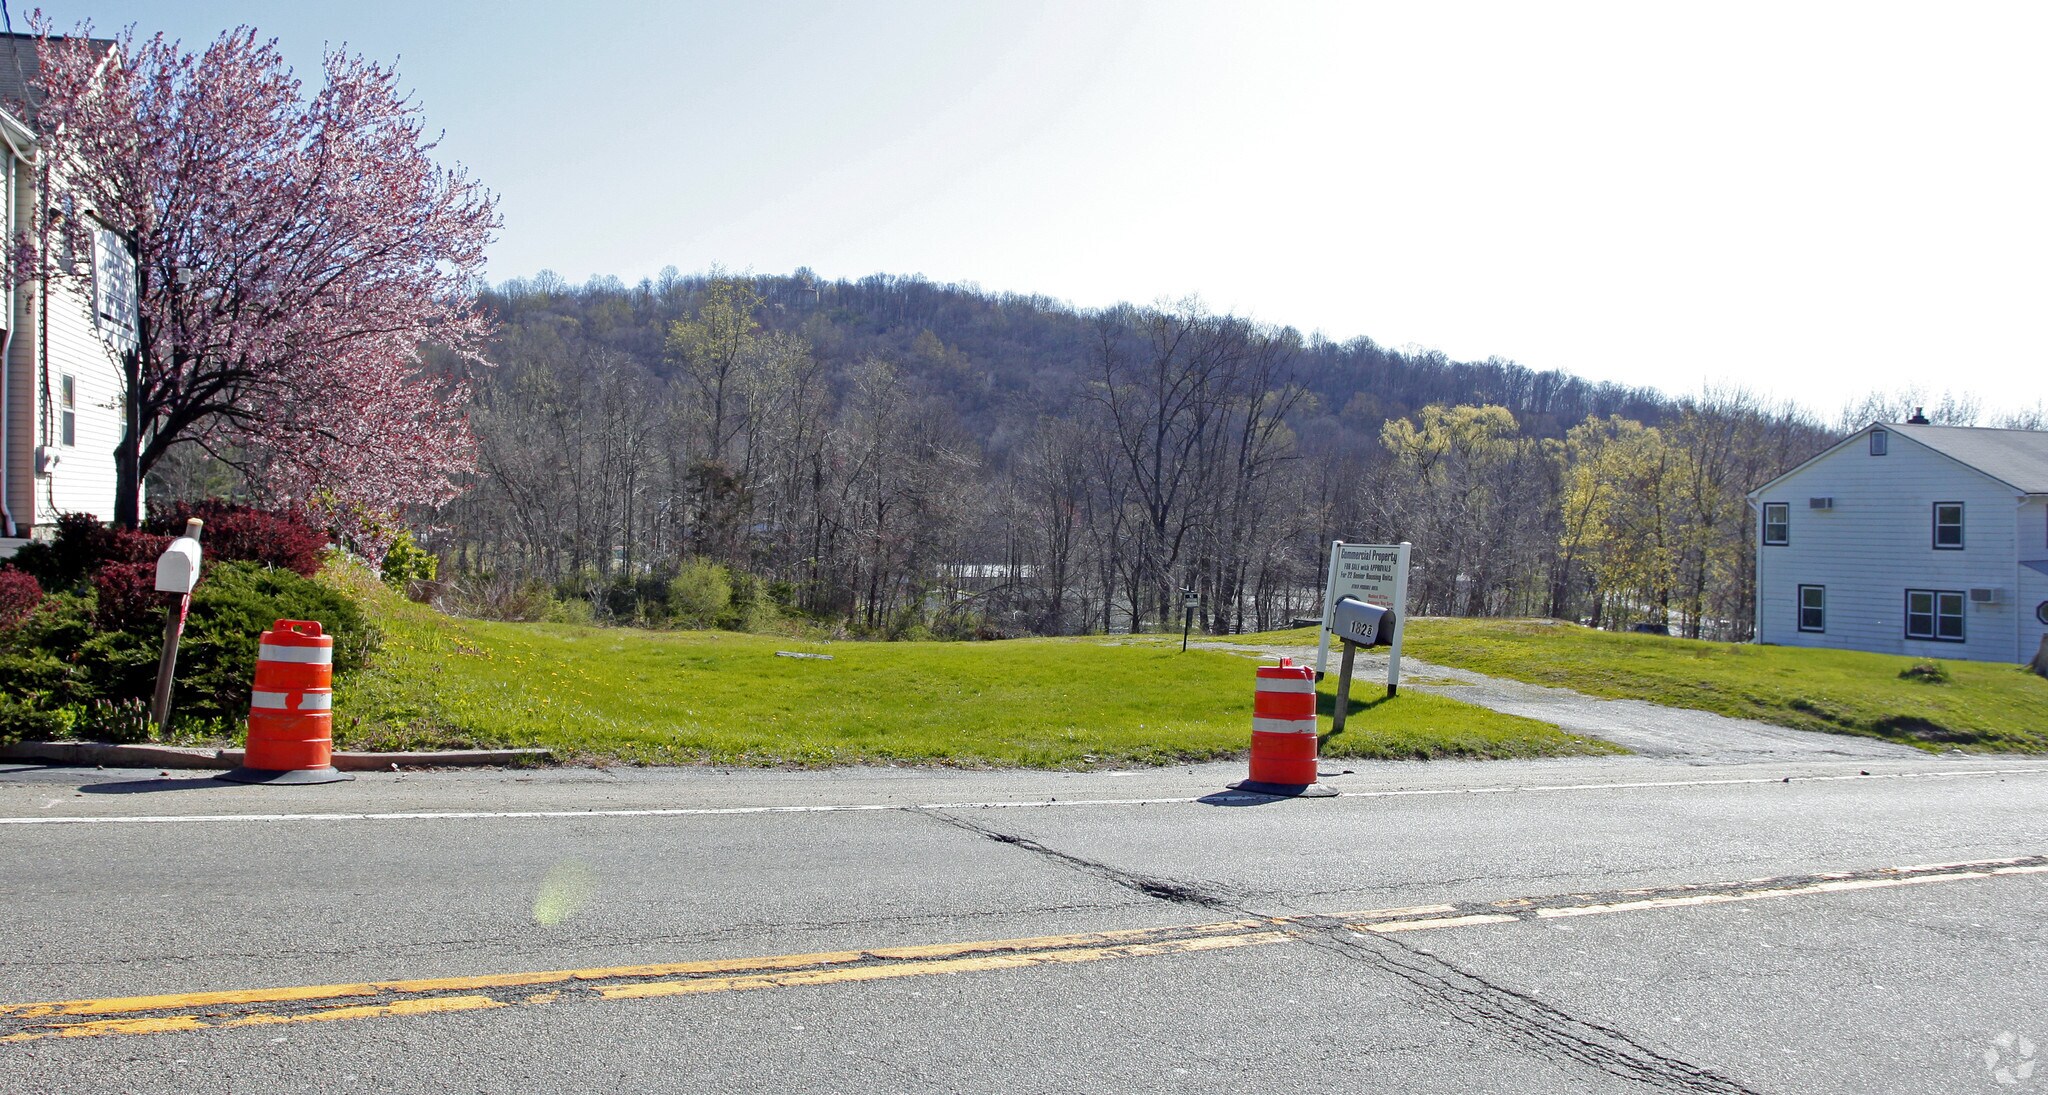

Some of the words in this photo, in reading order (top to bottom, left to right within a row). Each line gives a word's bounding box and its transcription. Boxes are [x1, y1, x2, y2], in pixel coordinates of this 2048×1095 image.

[1341, 548, 1371, 560] Commercial
[1372, 550, 1397, 564] Property
[1351, 563, 1360, 571] SALE
